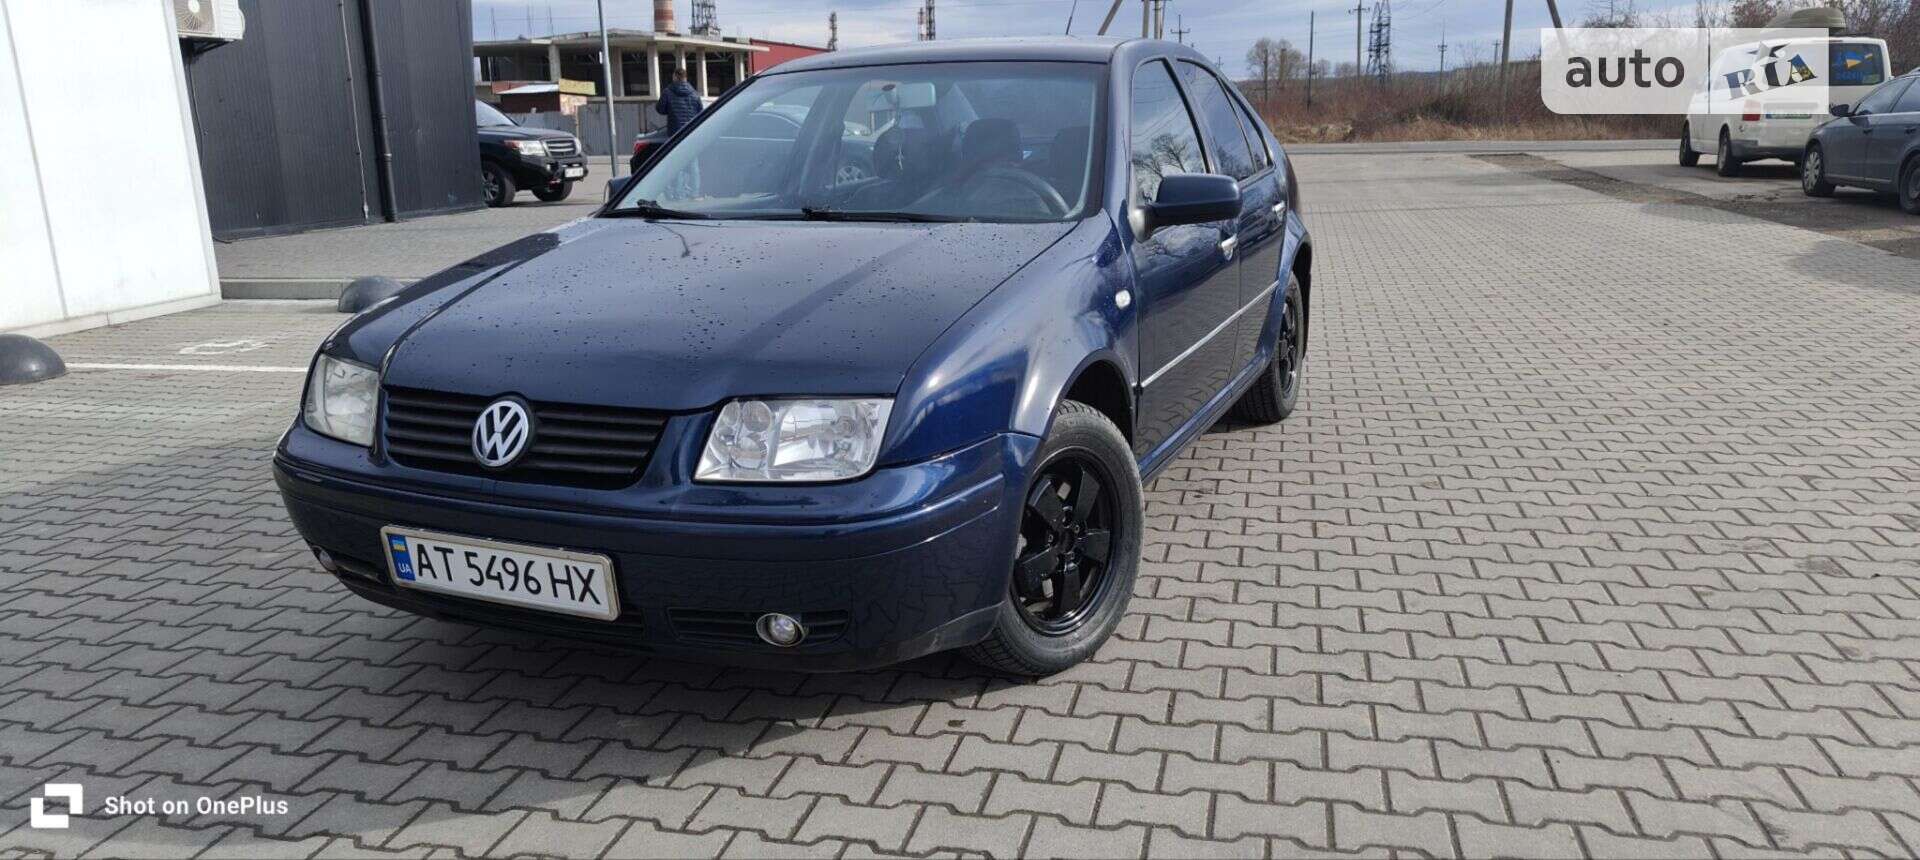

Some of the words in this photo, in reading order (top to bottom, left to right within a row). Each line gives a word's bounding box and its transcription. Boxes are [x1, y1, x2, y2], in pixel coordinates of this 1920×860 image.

[398, 562, 412, 575] UA
[416, 543, 455, 582] AT
[464, 551, 542, 595] 5496
[547, 562, 601, 605] HX
